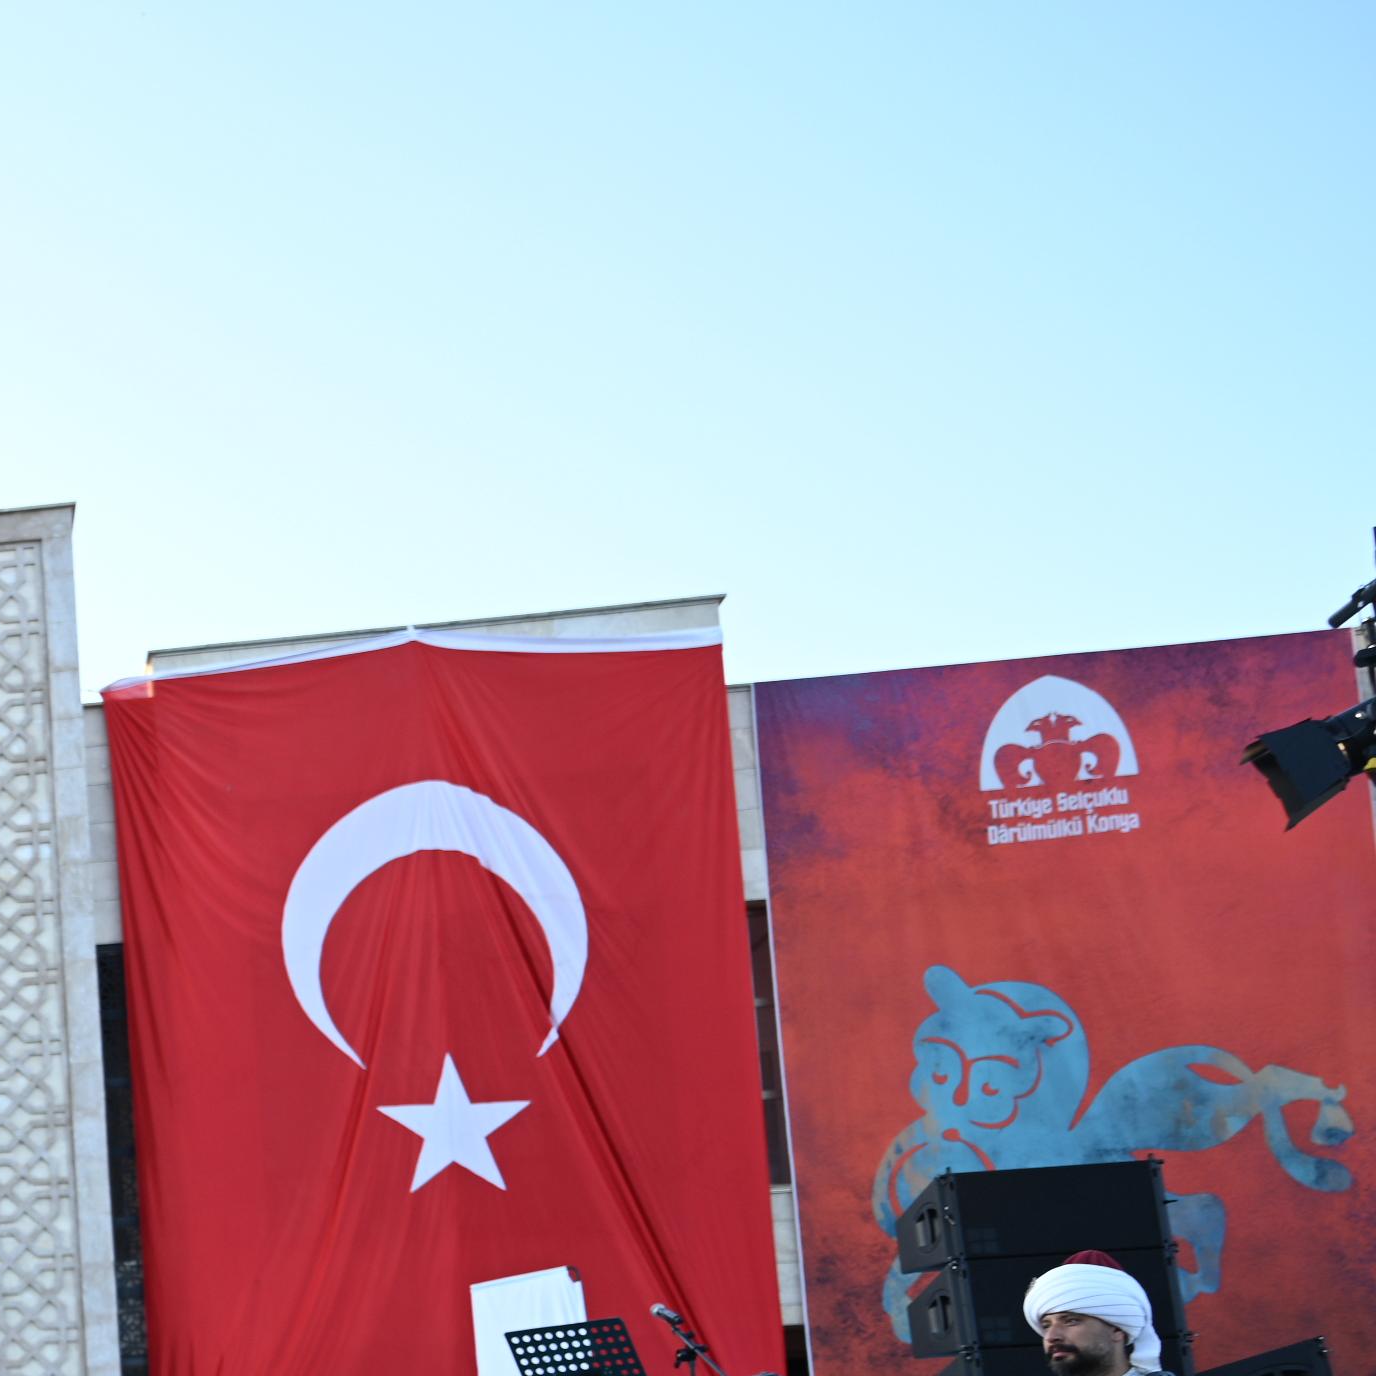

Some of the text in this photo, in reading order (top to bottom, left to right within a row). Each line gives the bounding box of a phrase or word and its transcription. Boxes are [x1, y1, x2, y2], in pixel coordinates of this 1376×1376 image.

[988, 786, 1129, 819] Türkiye Selçuklu
[988, 812, 1140, 845] Dârülmülkü Konya
